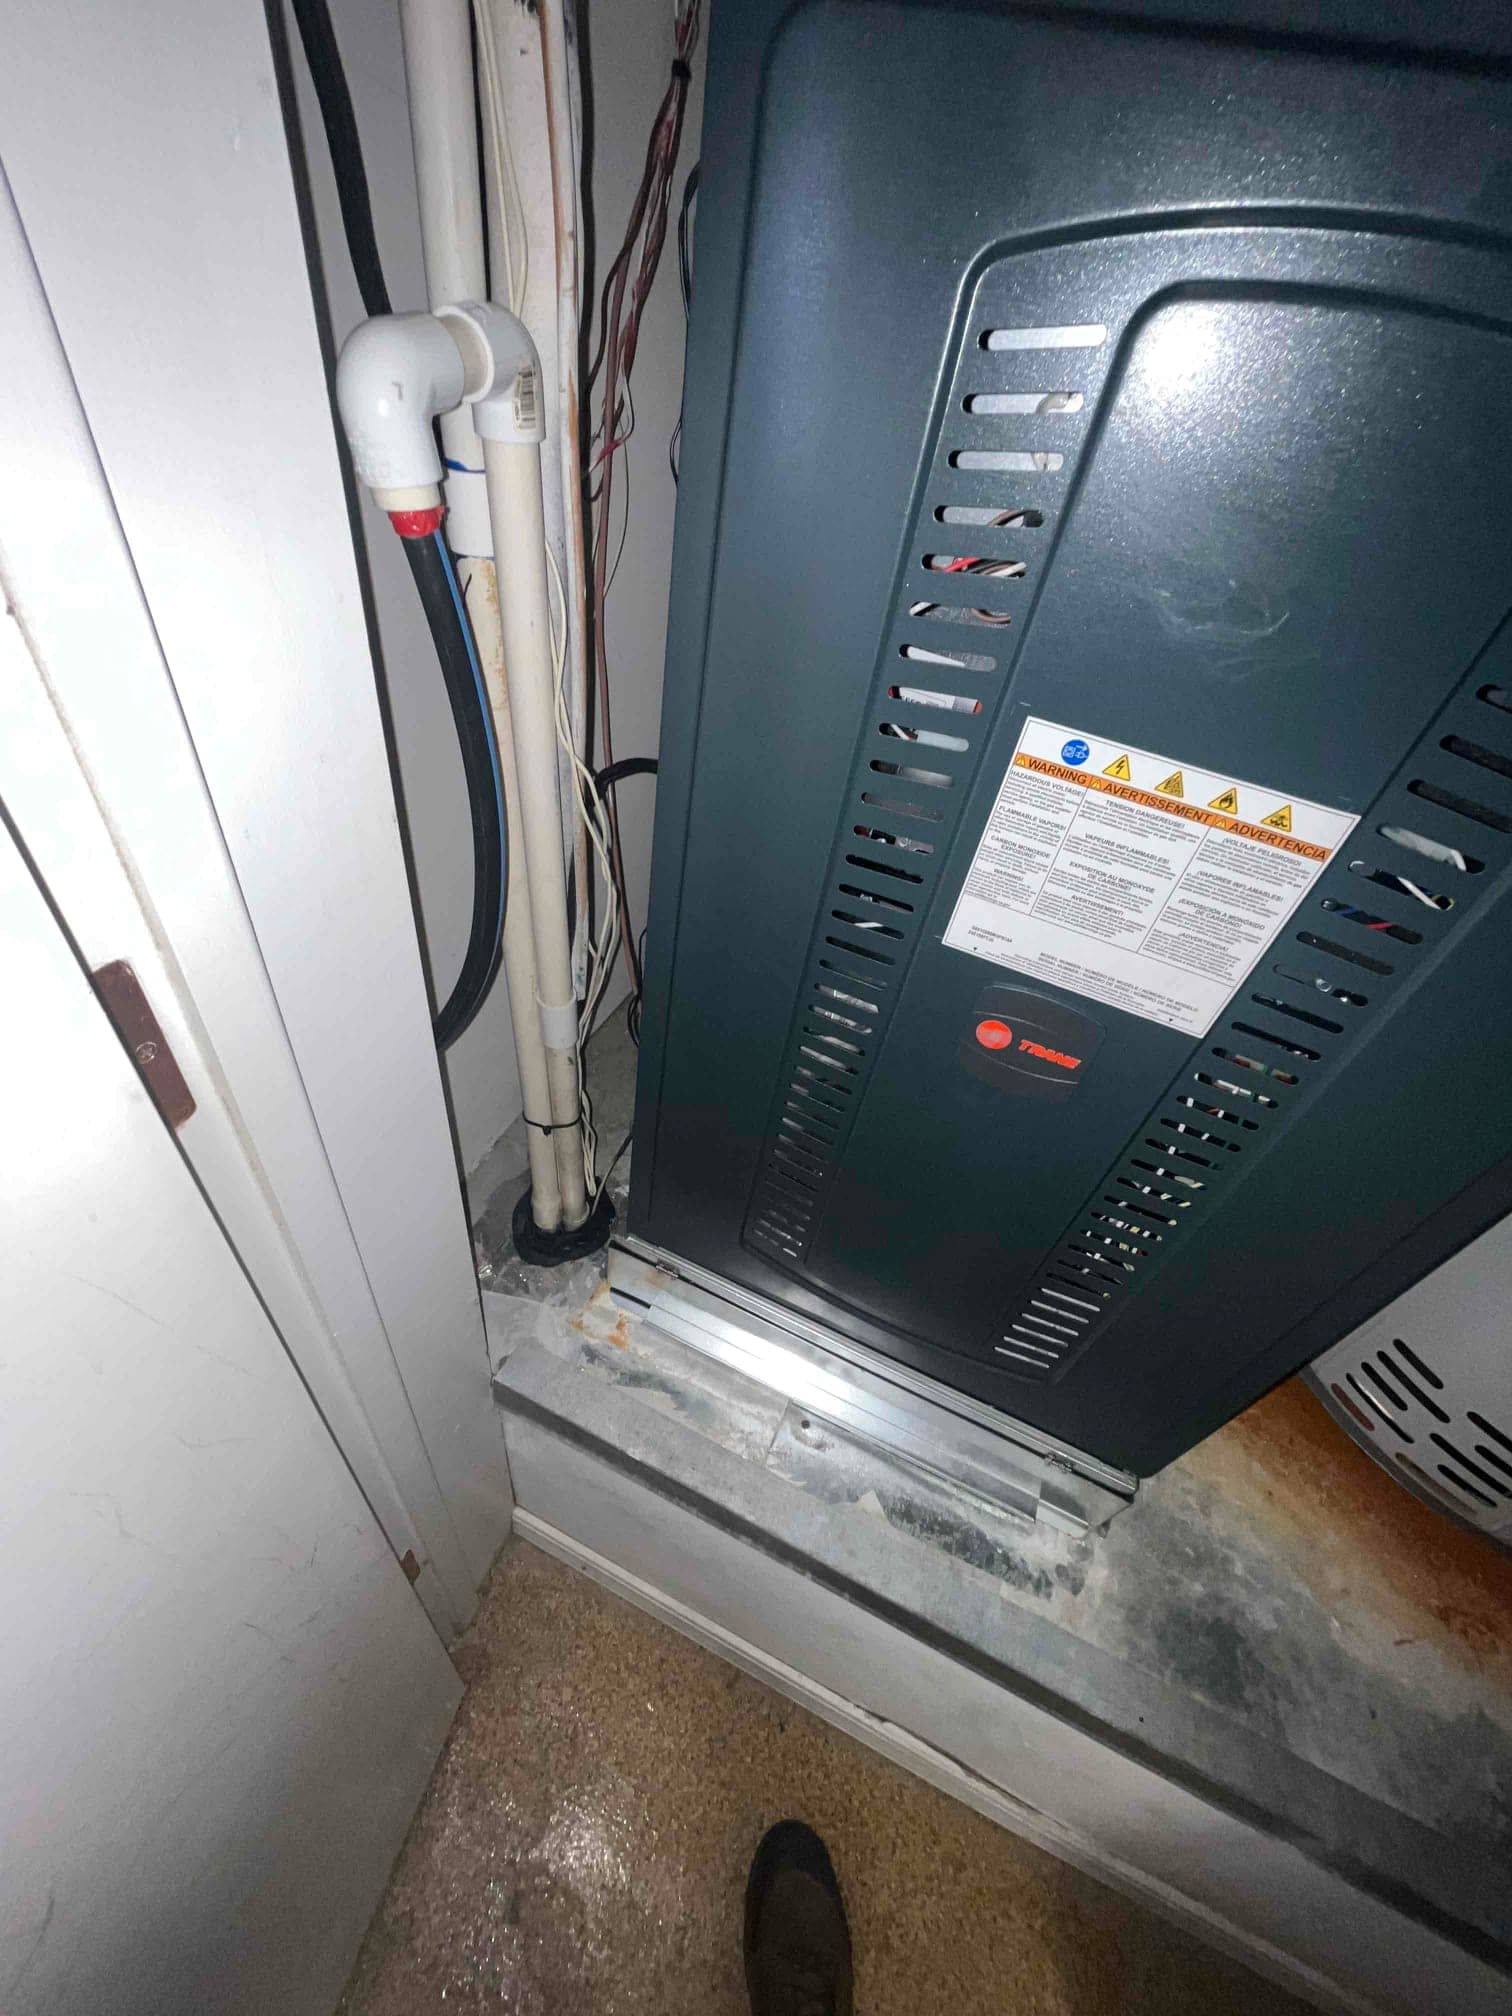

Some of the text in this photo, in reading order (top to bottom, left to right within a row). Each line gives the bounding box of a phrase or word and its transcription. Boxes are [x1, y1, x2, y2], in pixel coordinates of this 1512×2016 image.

[1010, 769, 1084, 797] HAZARDOUS VOLTAGE!
[1027, 758, 1088, 785] WARNING
[1102, 781, 1211, 823] AVERTISSEMENT
[1105, 799, 1185, 828] TENSION DANGEREUSE!
[998, 804, 1066, 831] FLAMMABLE VAPORS!
[990, 834, 1050, 858] CARBON MONOXIDE
[1000, 844, 1036, 859] EXPOSURE!
[1084, 832, 1170, 864] VAPEURS INFLAMMABLES!
[1227, 821, 1328, 860] ADVERTENCIA
[993, 868, 1024, 882] WARNING!
[1069, 861, 1155, 893] EXPOSITION AU MONOXYDE
[1097, 876, 1131, 891] CARBONE!
[1070, 894, 1123, 916] AVERTISSEMENT!
[1231, 881, 1284, 902] INFLAMABLES!
[1205, 913, 1242, 928] CARBONO!
[1019, 1039, 1082, 1070] TRANE
